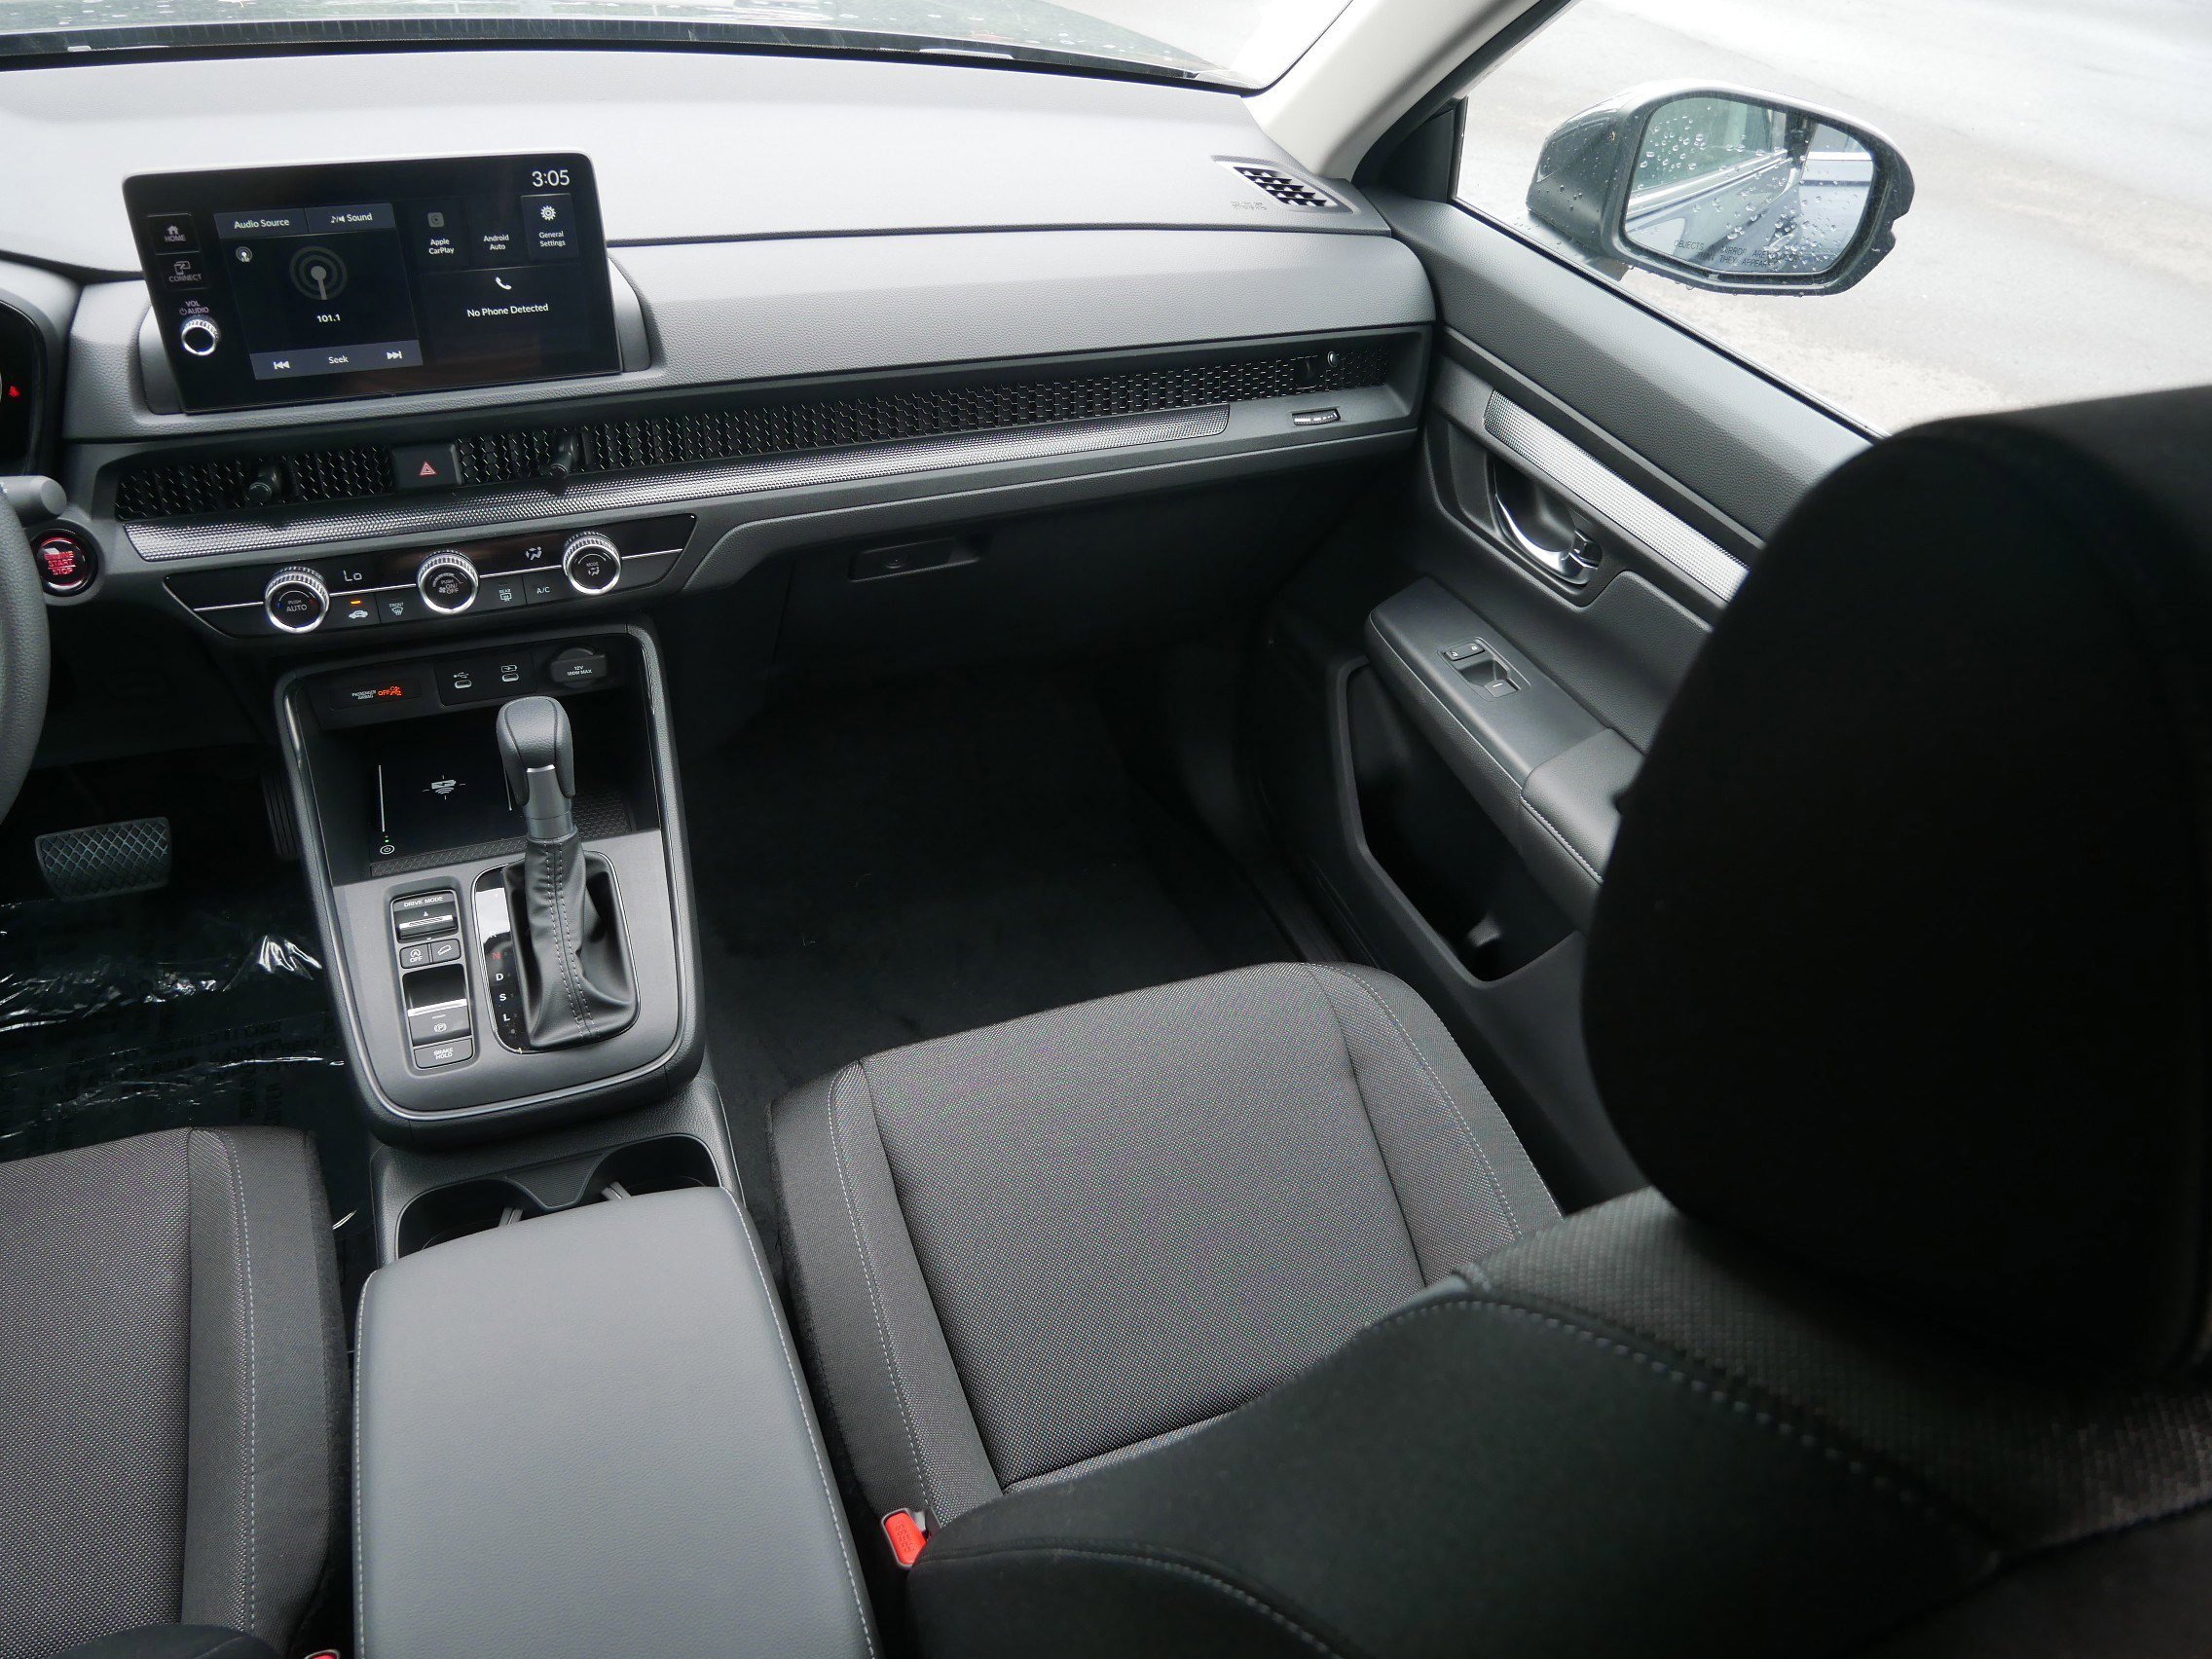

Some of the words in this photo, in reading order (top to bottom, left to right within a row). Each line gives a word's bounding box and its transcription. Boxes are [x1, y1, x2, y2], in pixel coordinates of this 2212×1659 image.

[532, 169, 571, 187] 3:05
[347, 212, 373, 222] Sound
[234, 219, 260, 230] Audio
[260, 218, 290, 228] Source
[165, 234, 187, 242] HOME
[483, 234, 510, 242] Android
[430, 239, 450, 248] Apple
[539, 240, 566, 248] Settings
[428, 246, 455, 256] CarPlay
[1673, 240, 1705, 250] OBJECTS
[1752, 249, 1767, 258] ARE
[1719, 255, 1737, 264] THEY
[168, 274, 203, 282] CONNECT
[466, 308, 481, 317] No
[482, 305, 509, 316] Phone
[510, 303, 549, 314] Detected
[316, 313, 341, 323] 101.1
[328, 354, 349, 364] Seek
[48, 558, 73, 568] START
[52, 567, 73, 575] STOP
[403, 898, 424, 907] DRIVE
[424, 895, 444, 904] MODE
[496, 973, 504, 981] D
[503, 1014, 511, 1022] L
